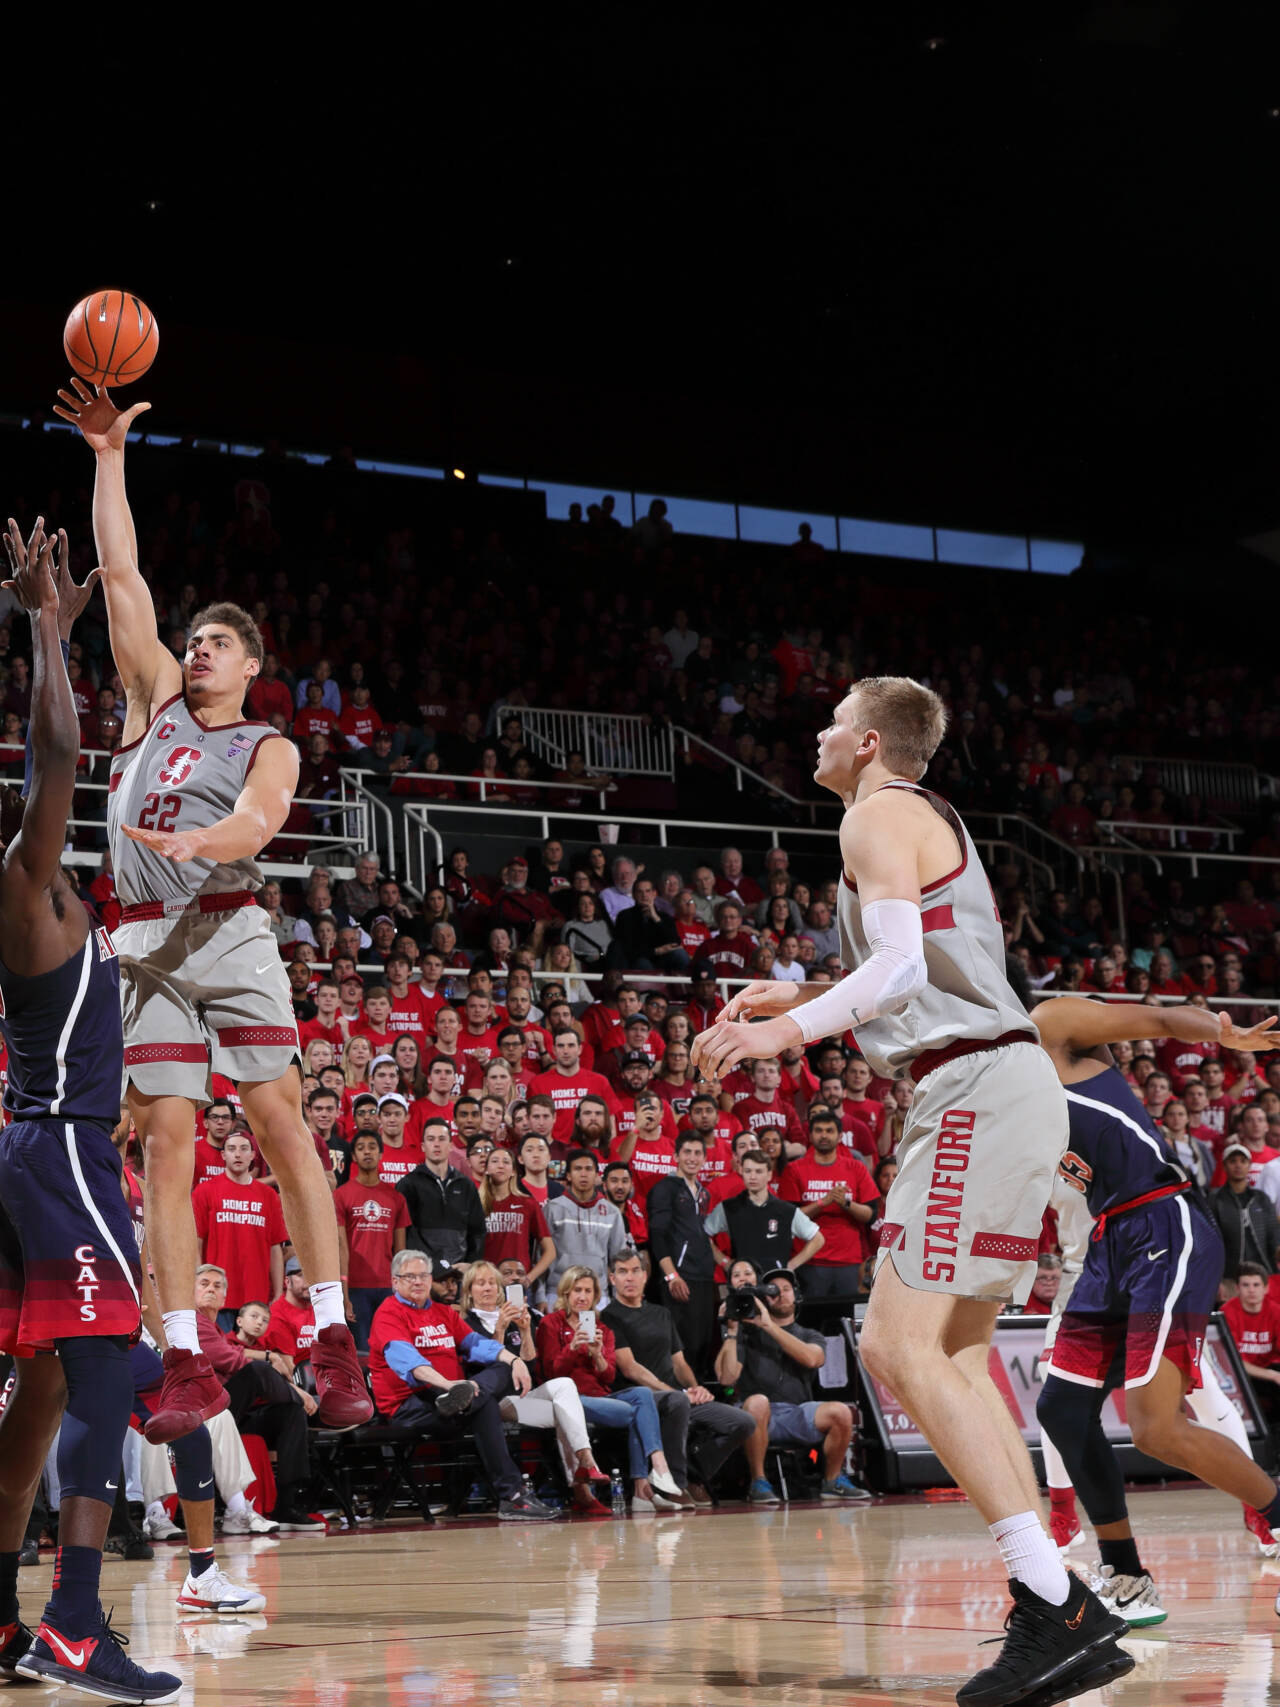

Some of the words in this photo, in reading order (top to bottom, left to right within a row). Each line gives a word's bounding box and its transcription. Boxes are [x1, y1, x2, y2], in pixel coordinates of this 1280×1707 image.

[157, 723, 175, 740] C
[137, 792, 182, 833] 22
[382, 1161, 407, 1172] HOME
[808, 1180, 833, 1191] HOME
[923, 1109, 978, 1284] STANFORD
[222, 1198, 249, 1211] HOME
[250, 1202, 263, 1213] OF
[74, 1245, 100, 1322] CATS
